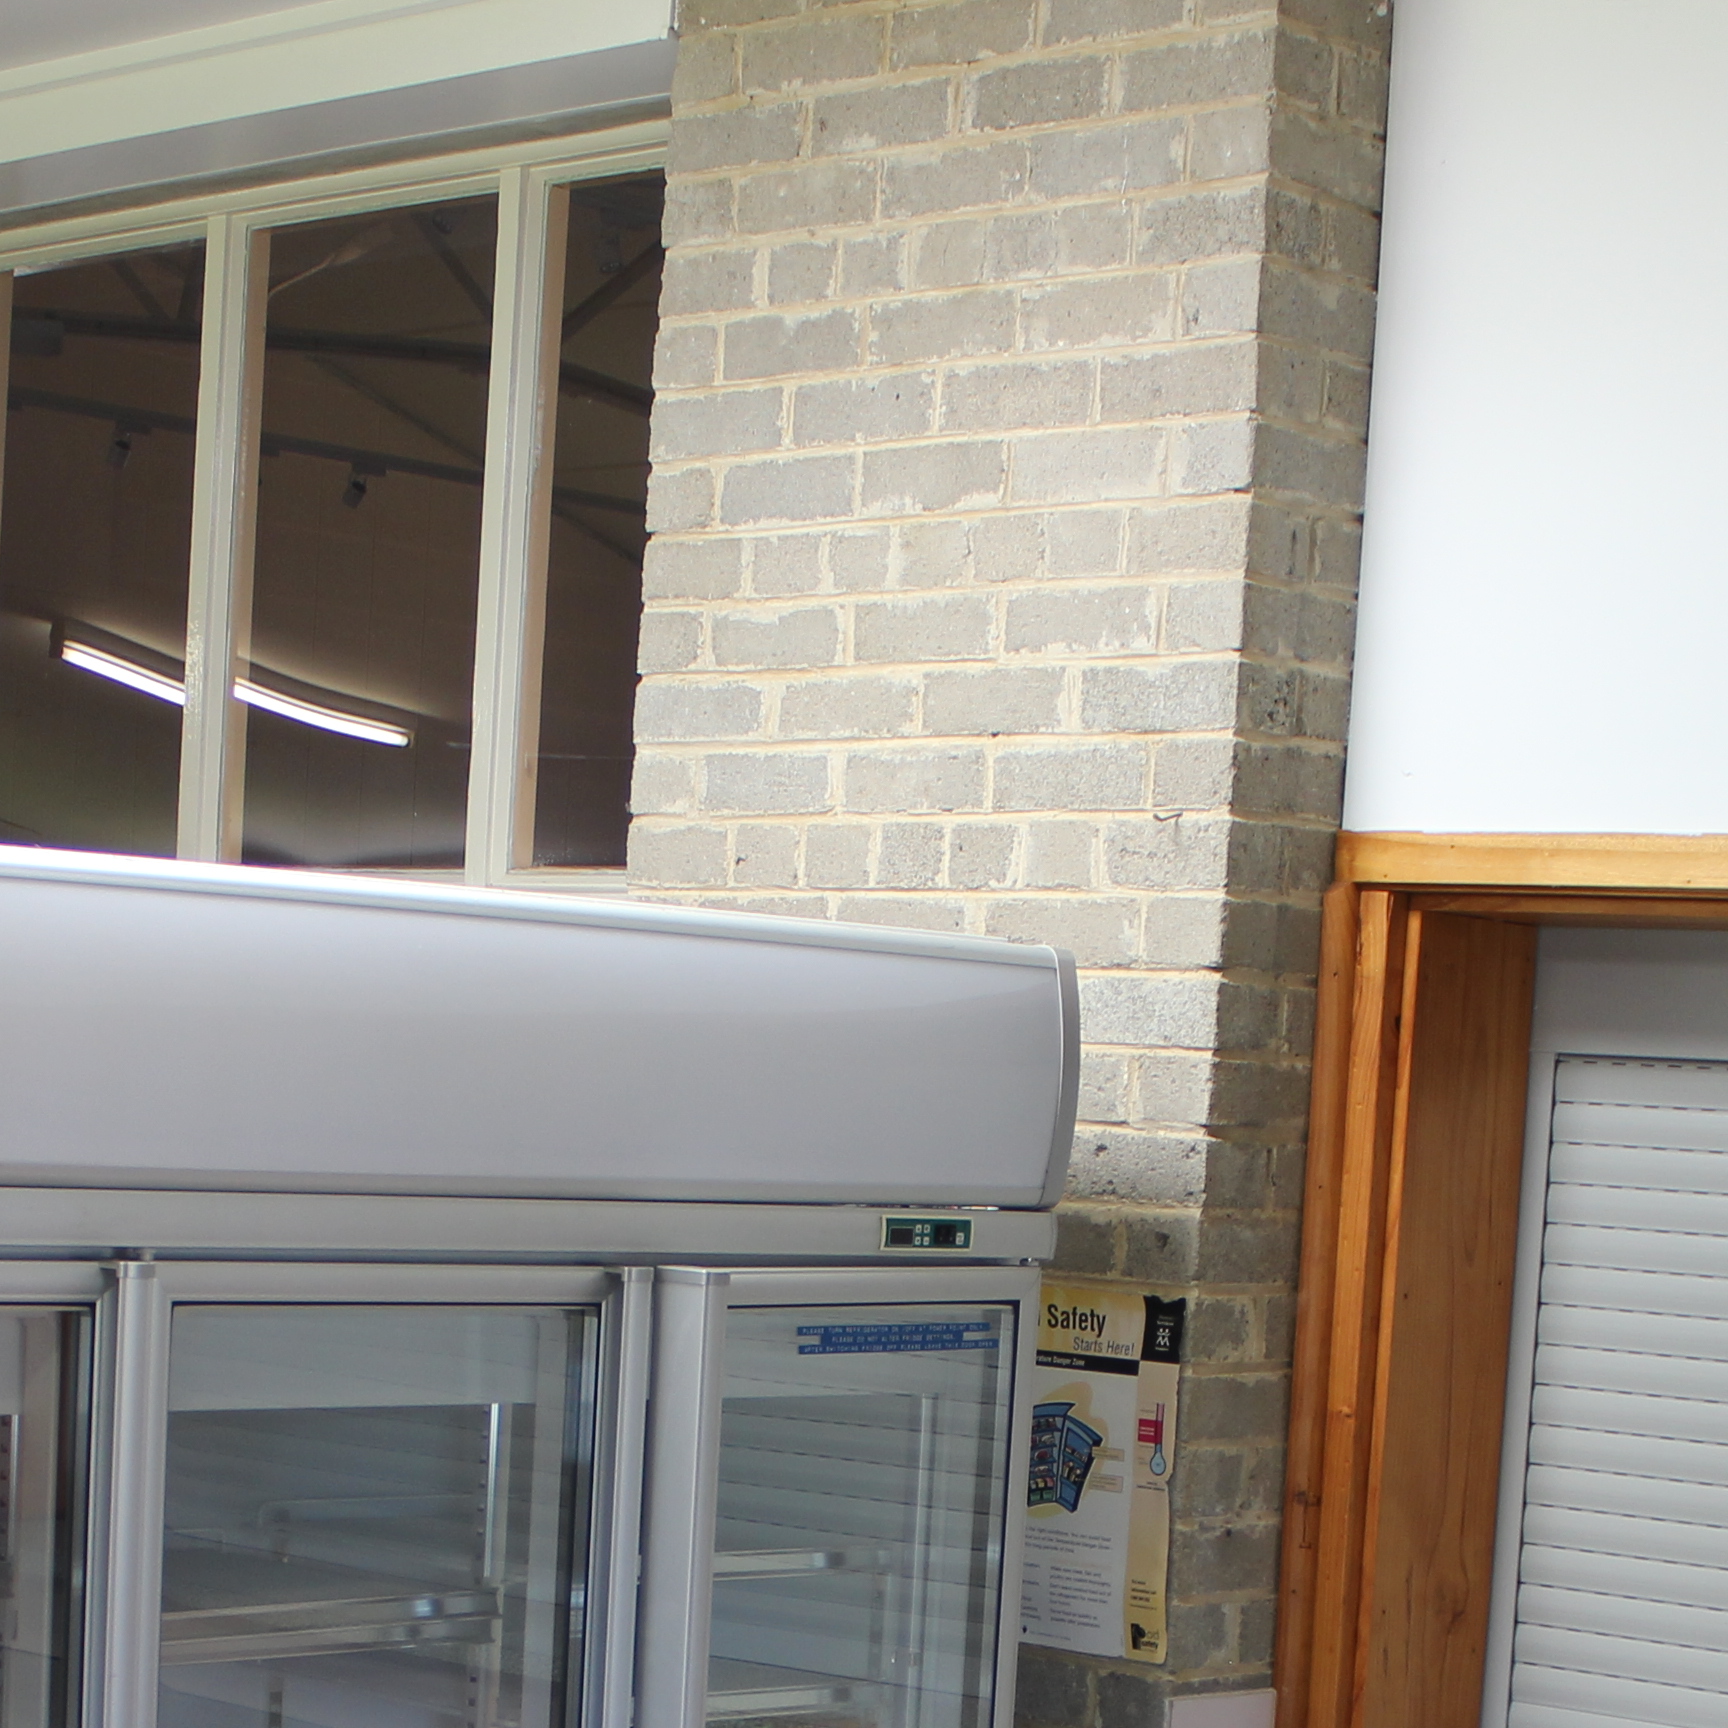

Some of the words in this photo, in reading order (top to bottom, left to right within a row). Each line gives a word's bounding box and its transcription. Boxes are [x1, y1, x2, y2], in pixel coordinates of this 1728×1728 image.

[1047, 1303, 1106, 1338] Safety
[1073, 1336, 1103, 1354] Starts
[1106, 1338, 1135, 1356] Here!
[1052, 1356, 1071, 1367] Danger
[1072, 1357, 1085, 1367] Zone
